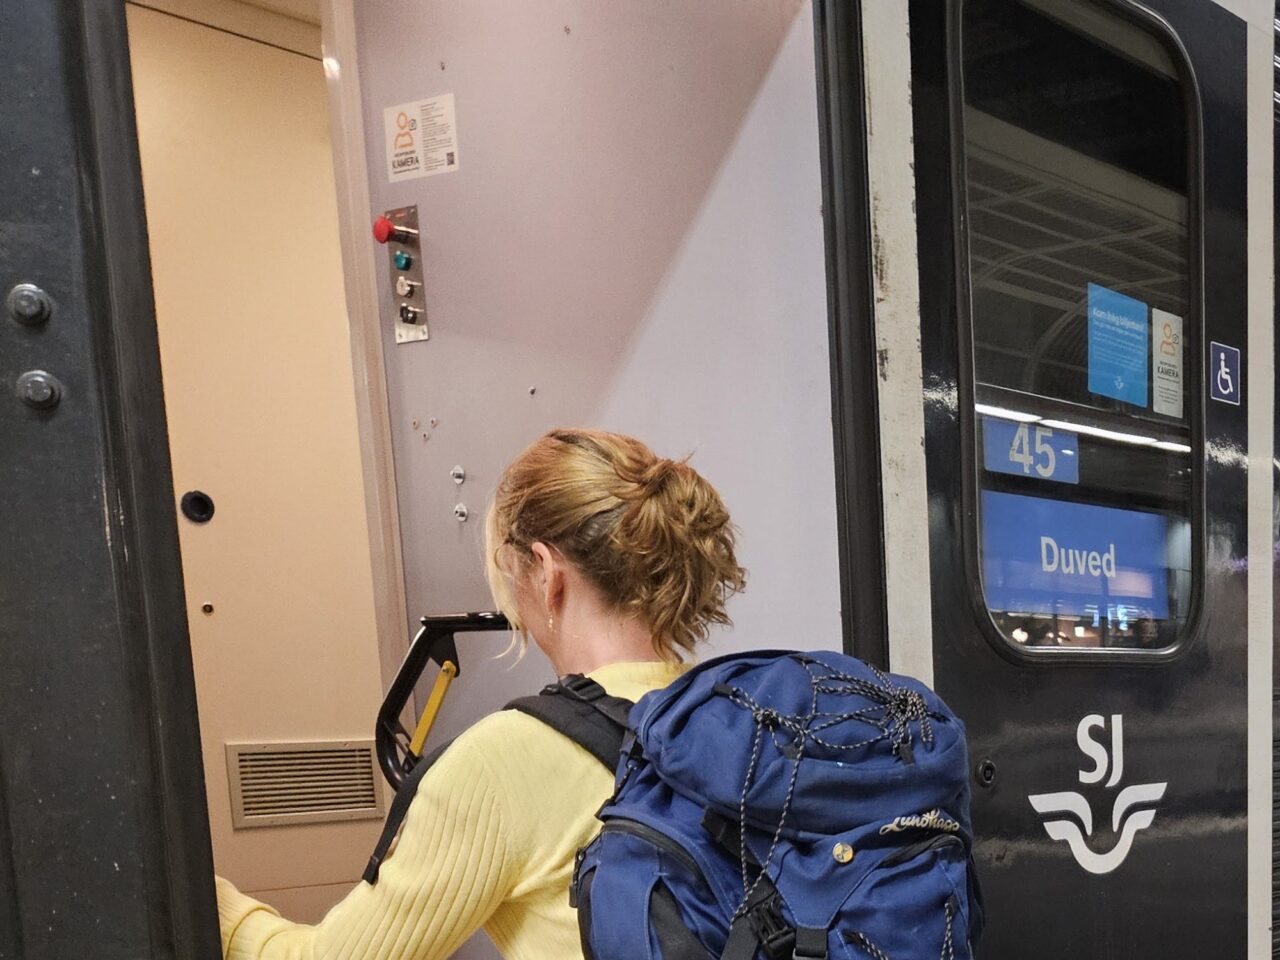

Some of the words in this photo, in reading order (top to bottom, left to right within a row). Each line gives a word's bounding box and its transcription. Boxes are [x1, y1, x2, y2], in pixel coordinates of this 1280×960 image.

[1157, 366, 1179, 378] KAMERA
[1009, 422, 1056, 477] 45
[1040, 536, 1117, 577] Duved
[1077, 714, 1124, 788] SJ
